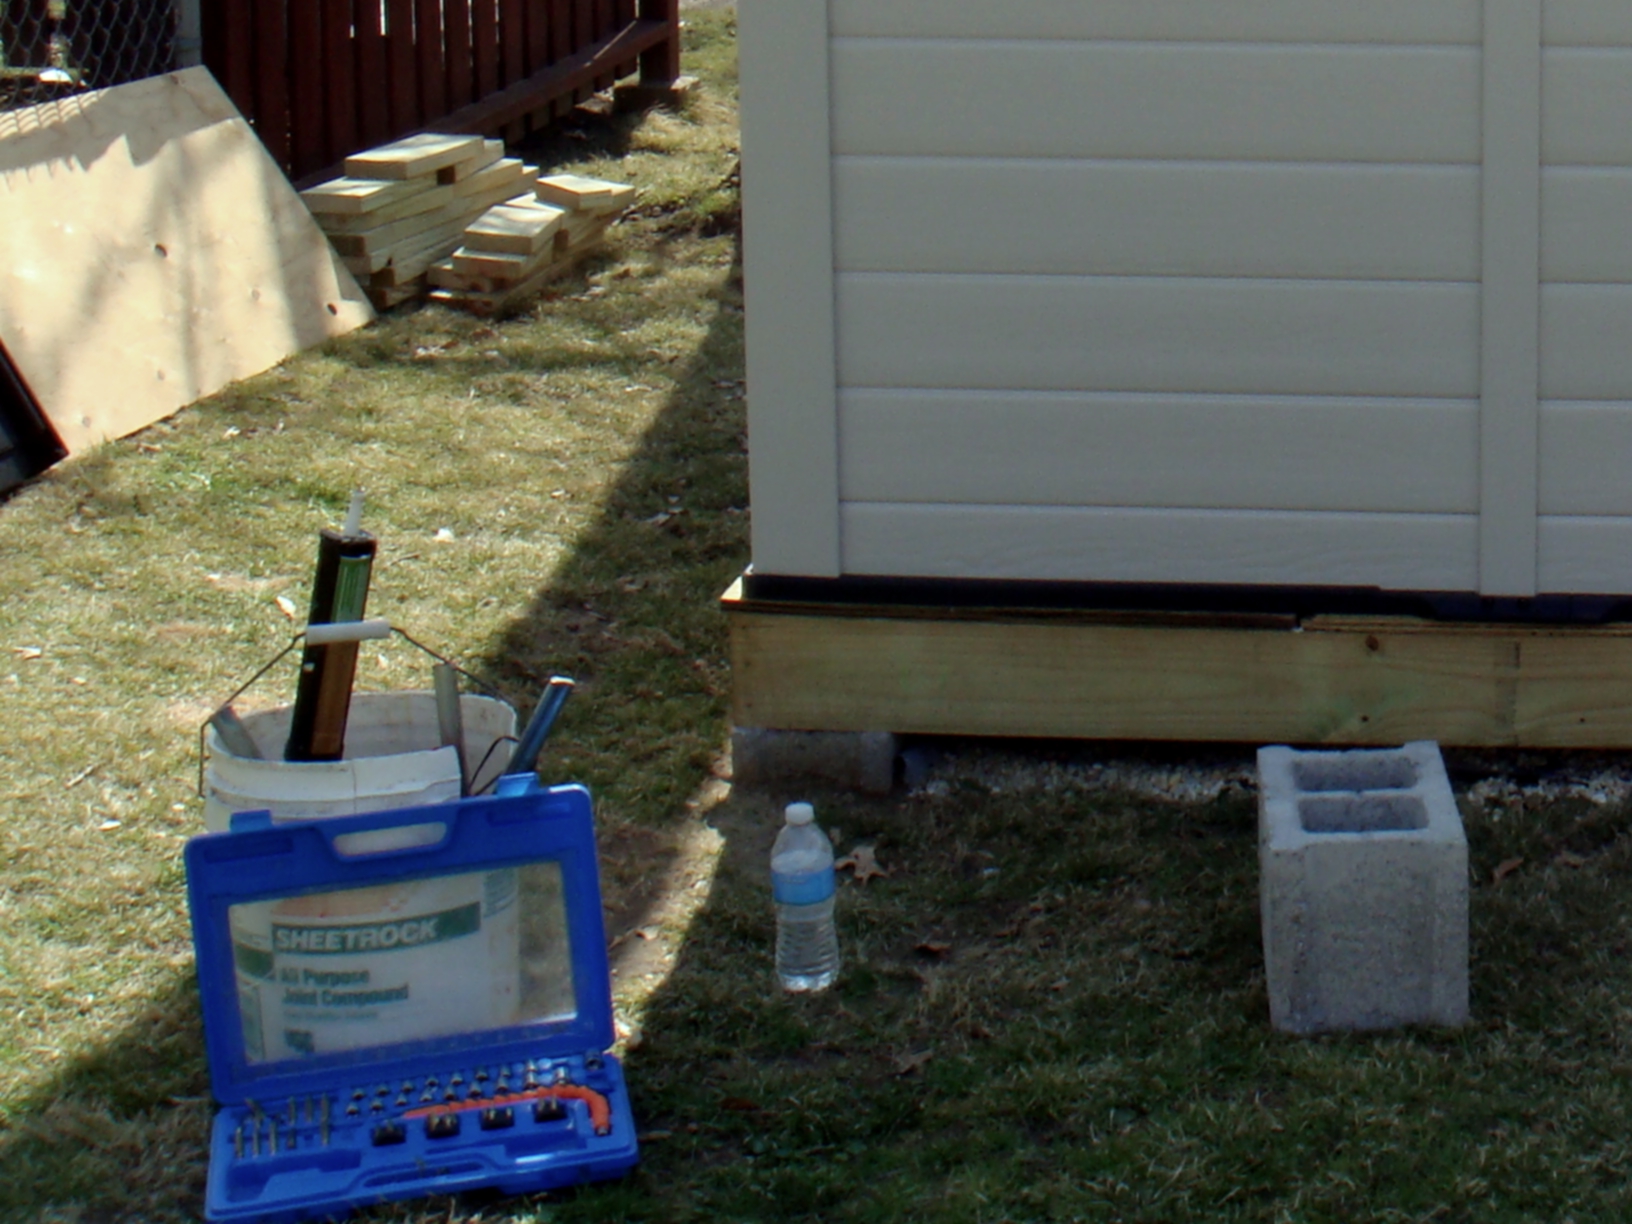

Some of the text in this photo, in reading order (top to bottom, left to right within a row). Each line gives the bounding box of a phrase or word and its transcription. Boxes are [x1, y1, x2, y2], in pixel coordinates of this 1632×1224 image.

[275, 917, 438, 950] SHEETROCK
[303, 967, 371, 987] Purpose
[321, 982, 409, 1006] Compound
